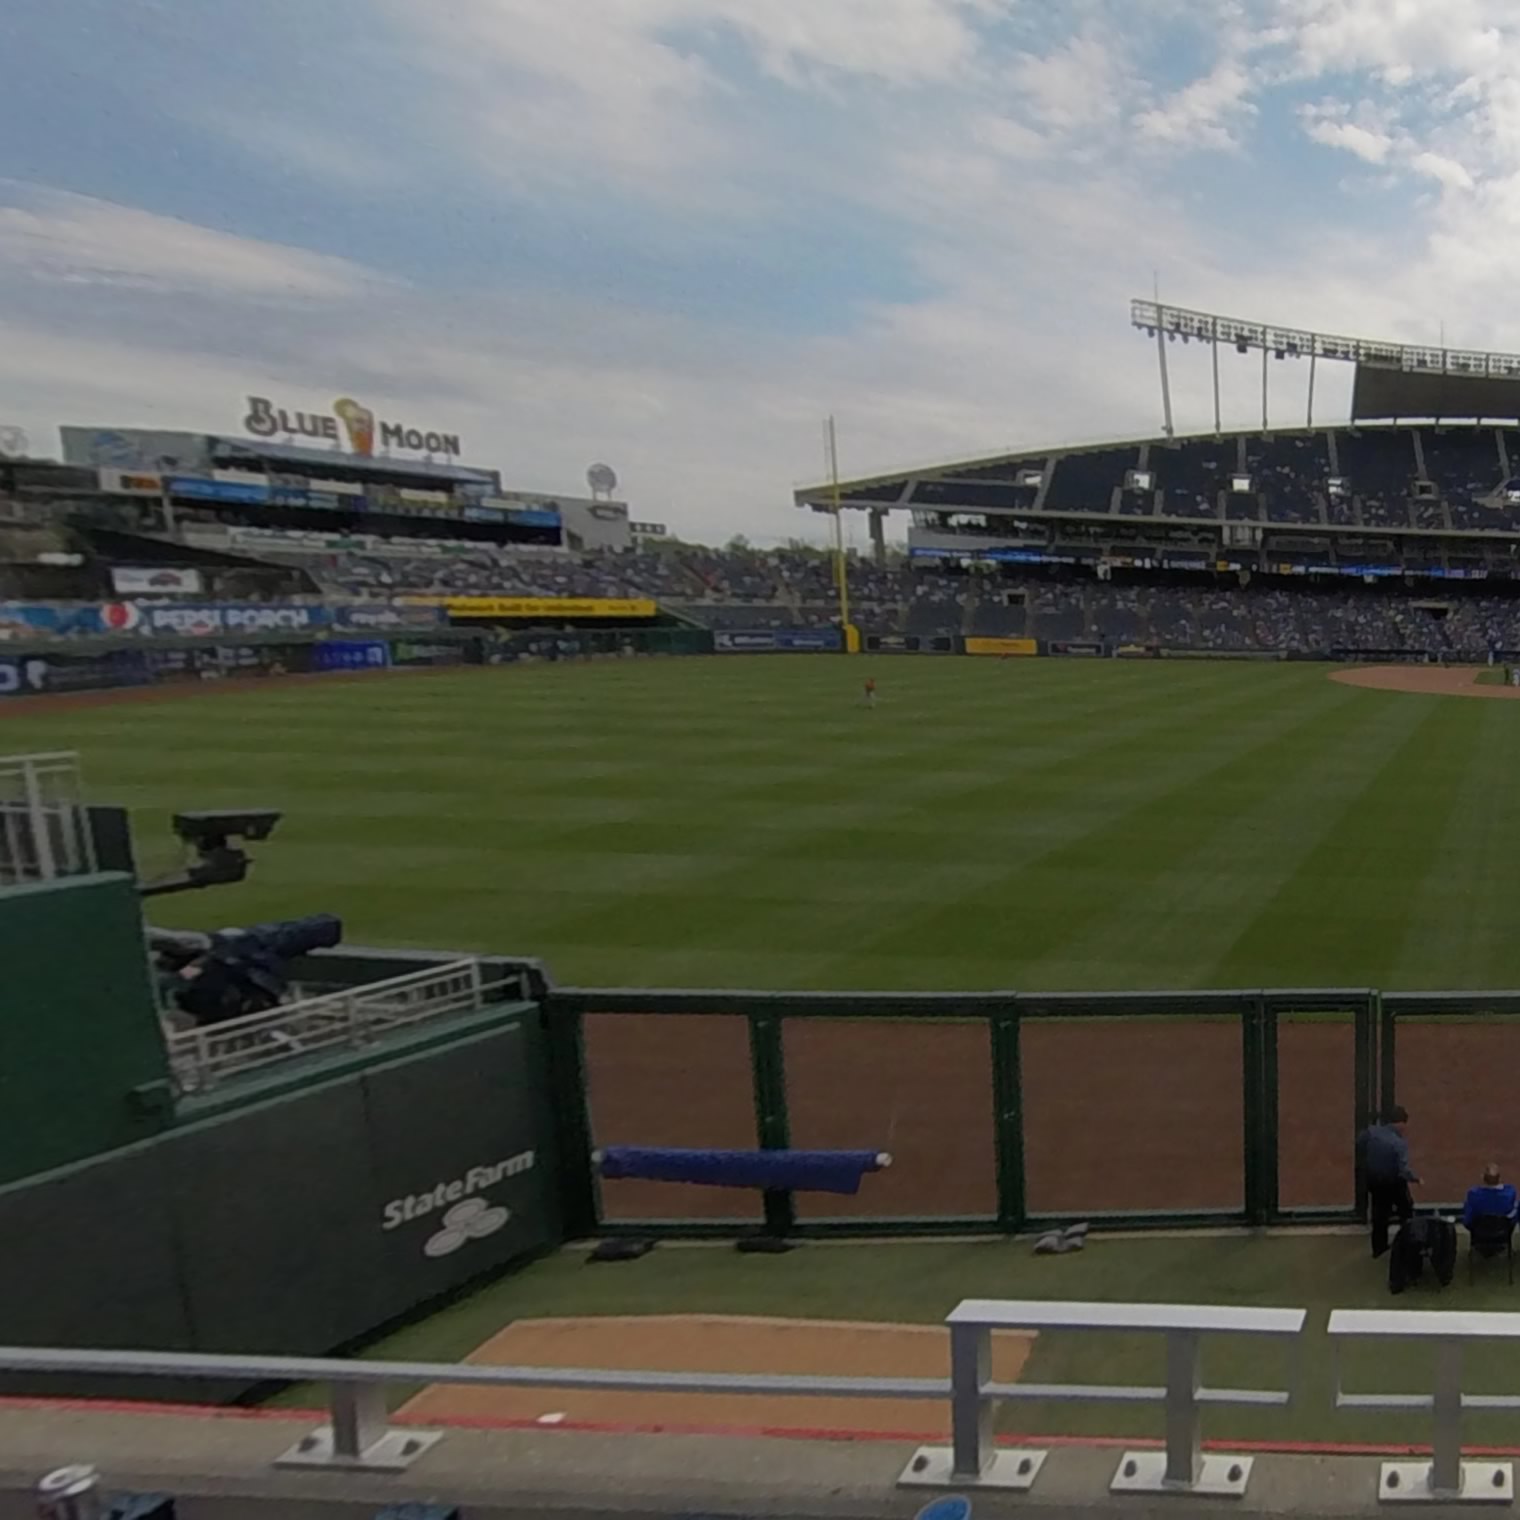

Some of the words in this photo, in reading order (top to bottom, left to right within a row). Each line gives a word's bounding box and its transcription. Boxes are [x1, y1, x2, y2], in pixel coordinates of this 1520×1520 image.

[245, 396, 339, 440] BLUE
[380, 421, 461, 456] MOON
[153, 609, 221, 630] PEPSI
[228, 609, 309, 628] PORCH
